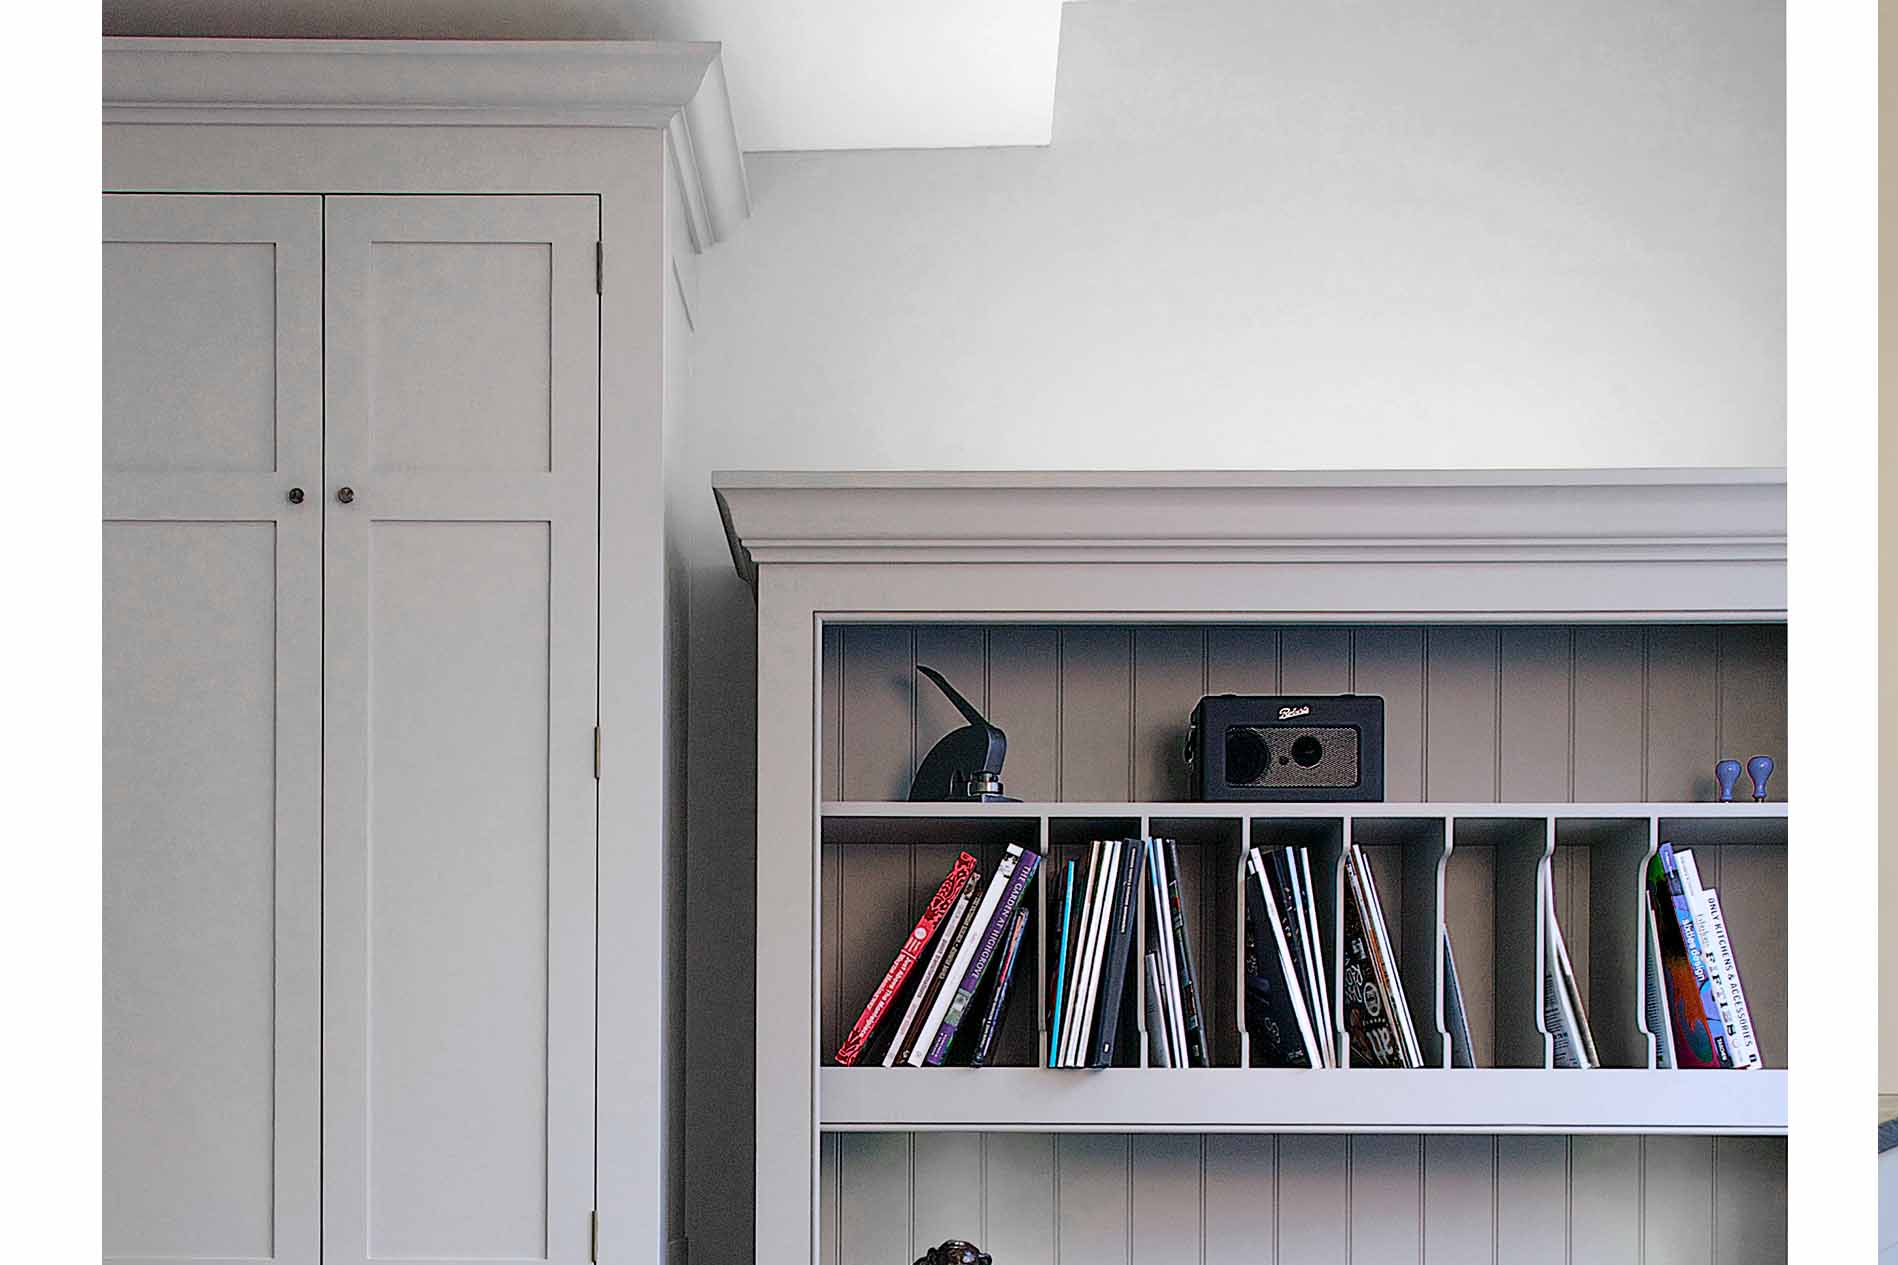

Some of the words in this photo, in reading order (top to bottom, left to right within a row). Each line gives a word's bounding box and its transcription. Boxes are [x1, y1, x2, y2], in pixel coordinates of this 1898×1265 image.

[1022, 866, 1031, 883] THE
[1002, 884, 1023, 917] GARDEN
[1681, 917, 1698, 948] sixties
[971, 927, 1001, 979] HIGHGROVE
[1688, 947, 1706, 981] design
[1706, 896, 1719, 921] ONLY
[1713, 922, 1733, 971] KITCHENS
[1729, 982, 1752, 1047] ACCESSORIES
[1705, 950, 1736, 1037] FIFTIES
